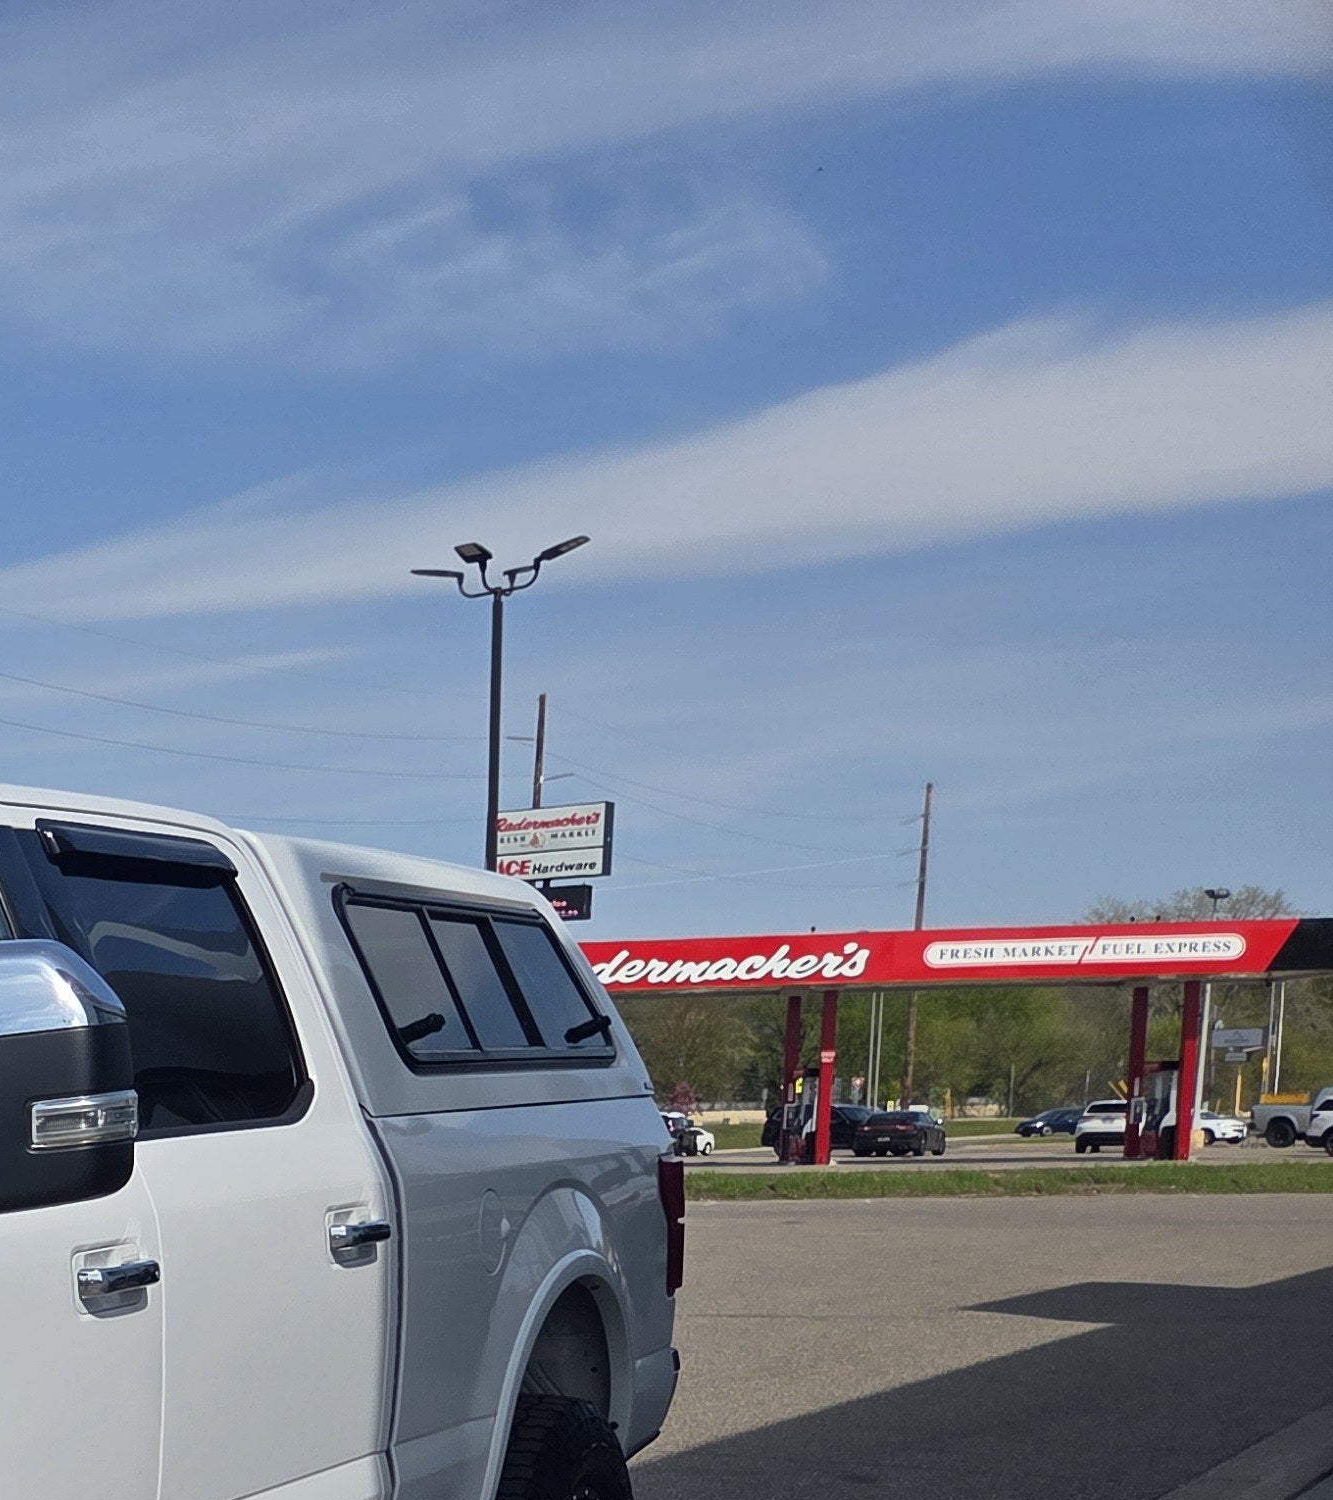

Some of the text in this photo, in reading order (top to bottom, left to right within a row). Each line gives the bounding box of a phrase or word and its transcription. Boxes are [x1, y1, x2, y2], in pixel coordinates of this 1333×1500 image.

[499, 829, 596, 844] RESH MARKET
[498, 859, 597, 876] ACE Hardware
[939, 940, 1233, 960] FRESH MARKET FUEL EXPRESS
[591, 942, 871, 985] dermacher's
